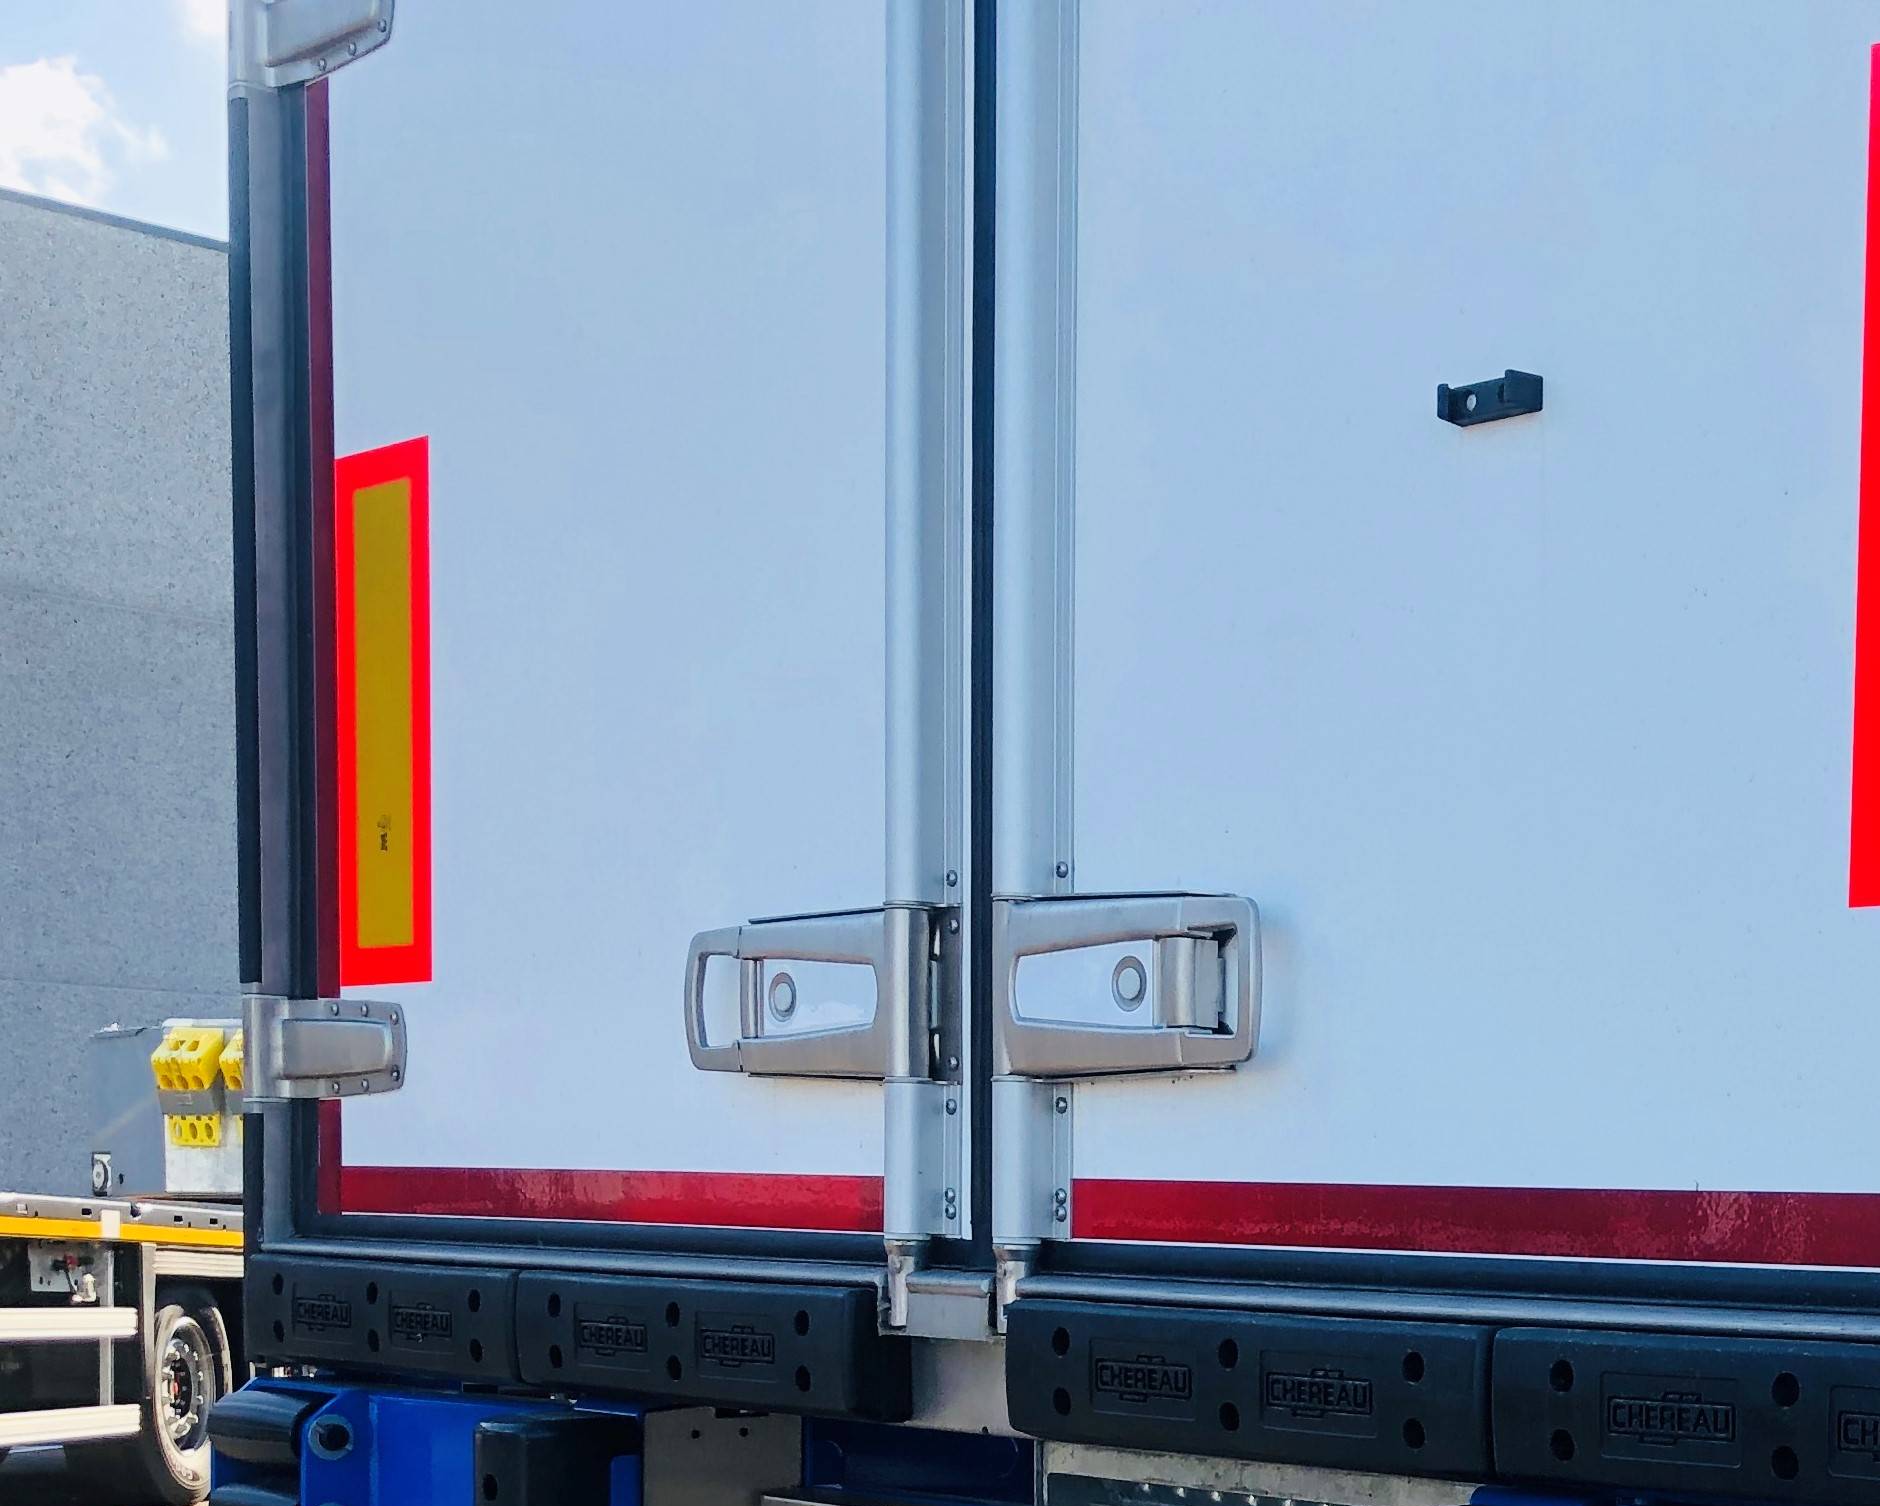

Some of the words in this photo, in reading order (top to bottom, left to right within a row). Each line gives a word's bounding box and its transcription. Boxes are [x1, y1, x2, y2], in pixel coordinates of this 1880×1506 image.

[298, 1302, 350, 1324] CHEREAU
[394, 1311, 450, 1332] CHEREAU
[581, 1325, 645, 1348] CHEREAU
[702, 1334, 772, 1358] CHEREAU
[1099, 1364, 1188, 1393] CHEREAU
[1269, 1378, 1368, 1409] CHEREAU
[1612, 1402, 1731, 1434] CHEREAU
